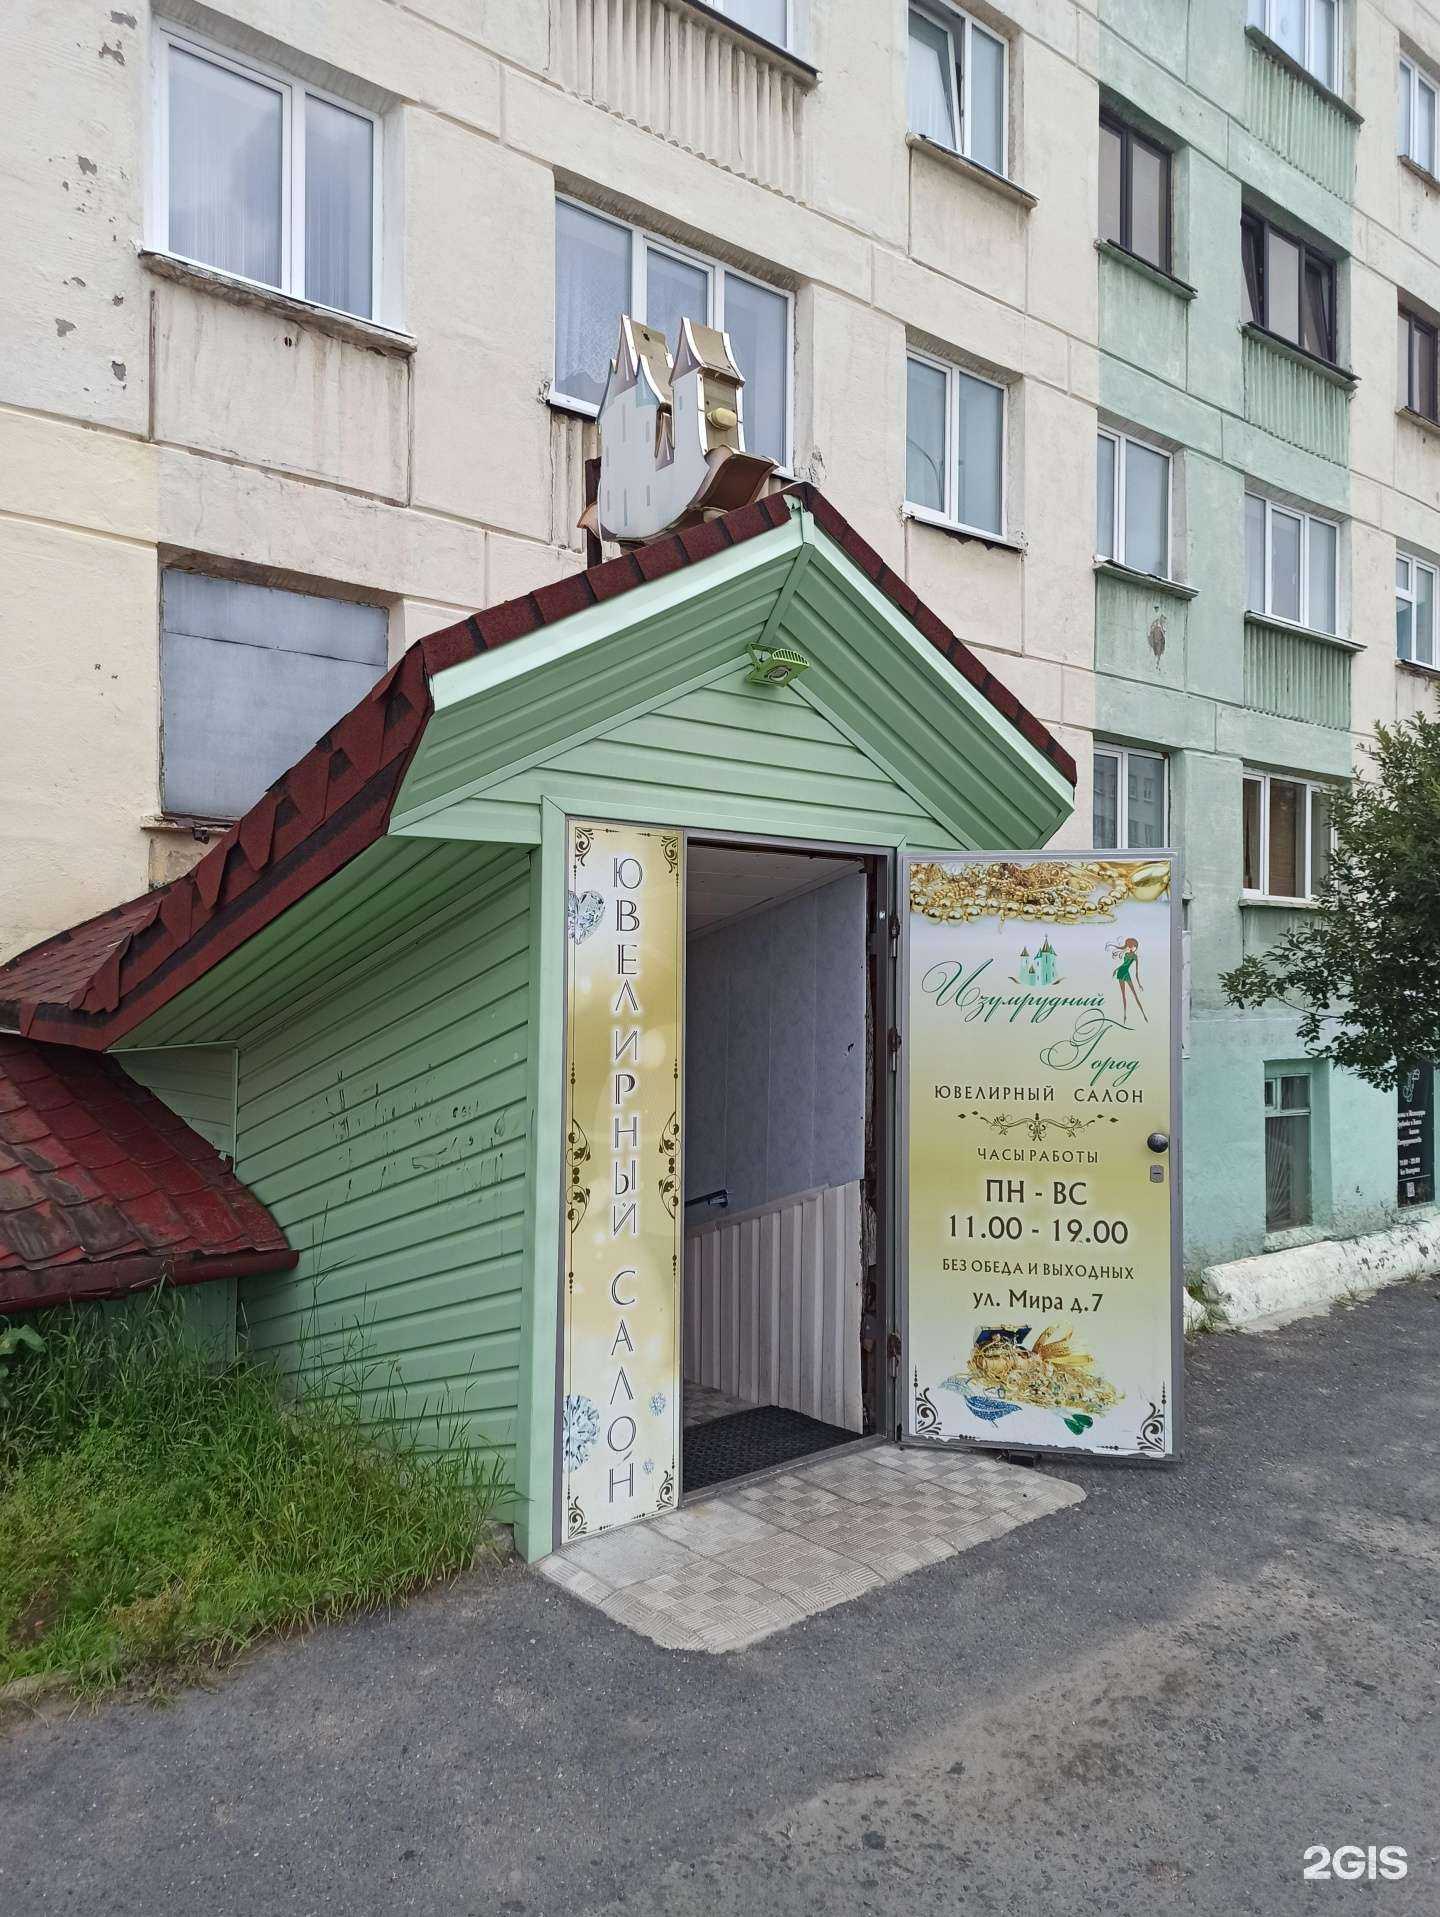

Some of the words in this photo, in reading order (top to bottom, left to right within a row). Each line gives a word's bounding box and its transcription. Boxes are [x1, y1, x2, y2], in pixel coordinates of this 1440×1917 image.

[921, 958, 1105, 1023] Изумрудный
[612, 856, 643, 1237] ЮВЕЛИРНЫЙ
[1039, 1008, 1140, 1086] Город
[934, 1083, 1055, 1102] ЮВЕЛИРНЫЙ
[1073, 1088, 1144, 1104] САЛОН
[977, 1147, 1025, 1162] ЧАСЫ
[1028, 1149, 1099, 1164] РАБОТЫ
[985, 1179, 1025, 1204] ПН
[1052, 1181, 1088, 1206] ВС
[949, 1214, 1023, 1240] 11.00
[1052, 1218, 1129, 1245] 19.00
[942, 1258, 967, 1273] БЕЗ
[971, 1259, 1023, 1276] ОБЕДА
[1028, 1262, 1040, 1276] И
[1043, 1263, 1135, 1281] ВЫХОДНЫХ
[972, 1290, 1001, 1309] ул.
[1008, 1289, 1064, 1313] Мира
[1070, 1293, 1104, 1315] д.7
[607, 1270, 637, 1503] САЛОН
